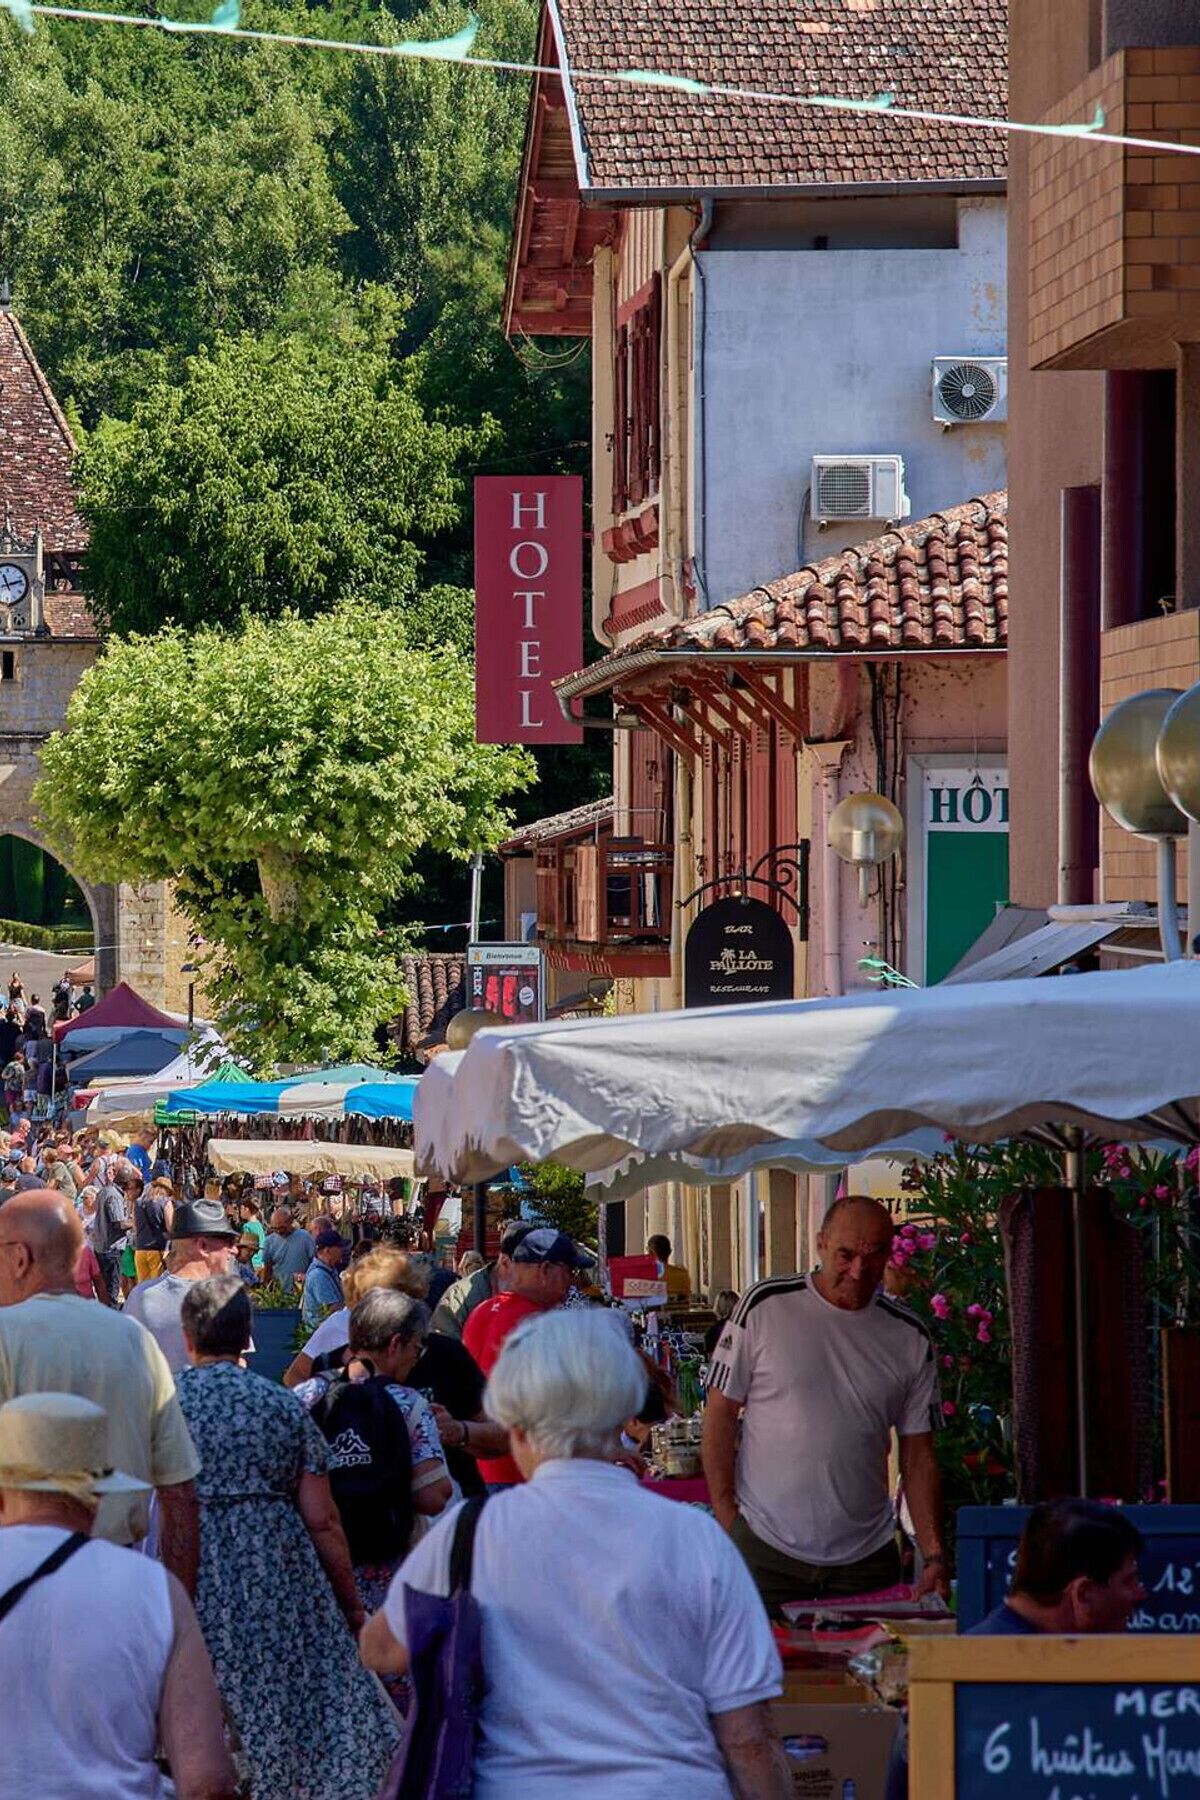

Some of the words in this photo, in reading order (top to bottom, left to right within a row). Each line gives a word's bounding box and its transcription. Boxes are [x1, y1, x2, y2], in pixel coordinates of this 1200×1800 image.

[509, 492, 550, 727] HOTEL
[723, 925, 754, 934] BAR
[738, 950, 757, 960] LA
[709, 984, 771, 993] RESTAURANT
[983, 1722, 1011, 1774] 6
